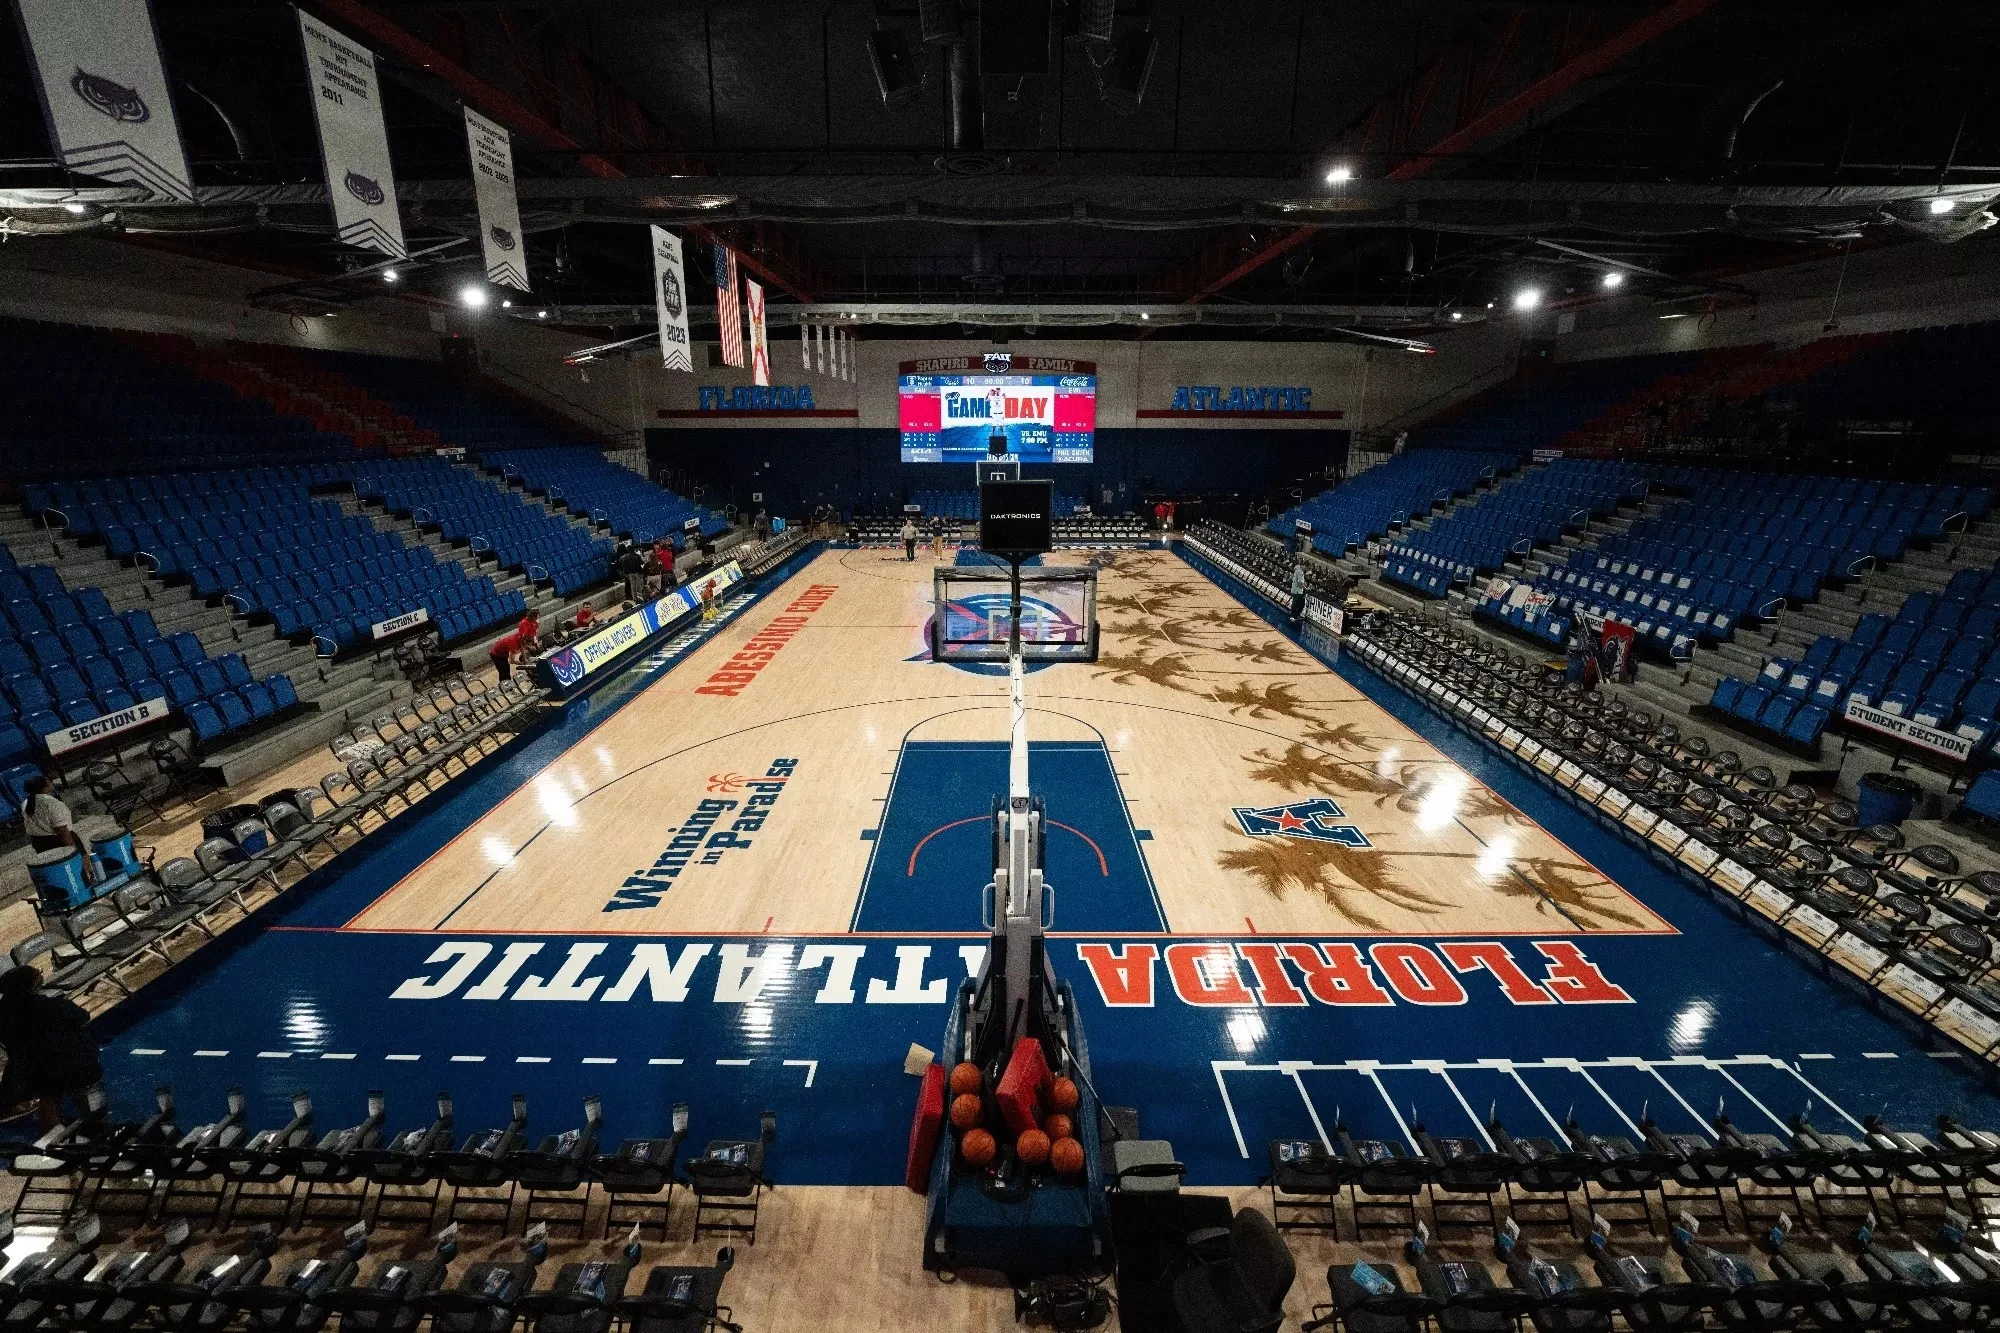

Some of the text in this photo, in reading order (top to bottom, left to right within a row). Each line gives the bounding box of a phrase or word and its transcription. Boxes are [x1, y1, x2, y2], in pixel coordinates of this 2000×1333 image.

[327, 37, 373, 69] BASKETBALL
[319, 55, 367, 88] TOURNAMENT
[321, 85, 344, 105] 2011
[324, 71, 368, 99] APPEARANCE
[666, 323, 686, 344] 2023
[916, 357, 969, 372] SHAPIRO
[982, 353, 1012, 361] FAU
[1028, 357, 1076, 372] FAMILY
[1059, 376, 1090, 387] Coca-Cola
[699, 385, 815, 410] FLORIDA
[1004, 397, 1049, 419] DAY
[1171, 385, 1312, 411] ATLANTIC
[1304, 595, 1332, 620] SHINER
[382, 614, 413, 633] SECTION
[583, 623, 637, 664] OFFICIAL MOVERS
[652, 634, 702, 657] MILES
[694, 616, 809, 696] ABESSINIO
[784, 584, 839, 613] COURT
[68, 706, 150, 743] SECTION B
[1850, 705, 1967, 754] STUDENT SECTION
[693, 757, 799, 865] in Paradise
[601, 798, 739, 912] Winning
[1076, 941, 1636, 1008] FLORIDA
